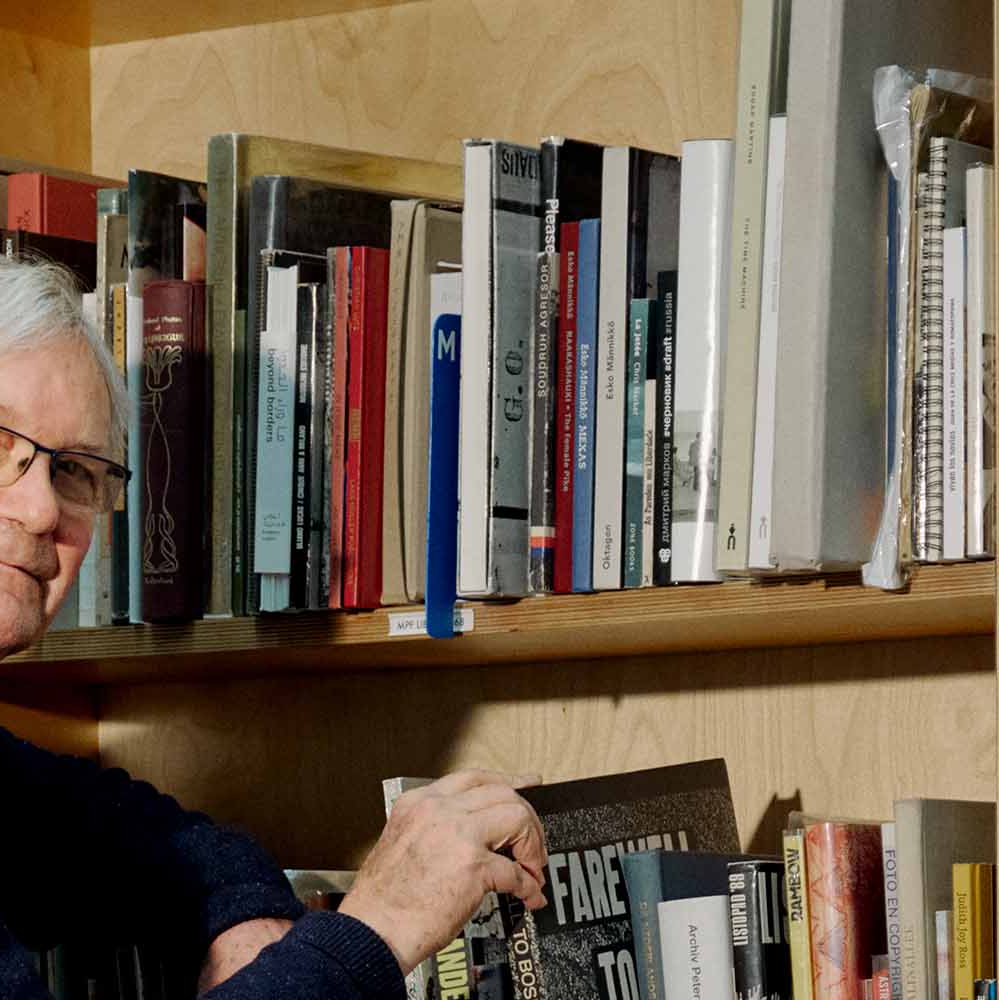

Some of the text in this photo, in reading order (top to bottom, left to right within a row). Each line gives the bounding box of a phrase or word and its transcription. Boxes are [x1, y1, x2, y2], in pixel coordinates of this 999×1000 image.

[544, 199, 560, 253] Please
[740, 266, 748, 310] MACHINE
[437, 328, 456, 361] M
[537, 264, 549, 398] SOUDRUH AGRESOR
[632, 319, 643, 385] La Chris
[562, 251, 575, 492] Esko The Female Pike
[580, 344, 589, 367] Esko
[606, 320, 616, 400] Esko Männikkö
[663, 334, 674, 373] #draft
[266, 349, 276, 443] beyond borders
[663, 373, 673, 438] #черновик
[578, 424, 587, 470] MEXAS
[661, 442, 671, 487] марков
[660, 488, 671, 543] дмитрий
[603, 524, 613, 570] Oktagon
[397, 620, 411, 629] MPF
[787, 848, 803, 922] RAMBOW
[885, 849, 897, 893] FOTO
[730, 894, 748, 946] LISTOPAD
[887, 898, 898, 918] EN
[957, 892, 969, 925] Judith
[510, 928, 529, 955] TO
[687, 924, 700, 962] Archiv
[957, 927, 969, 944] Joy
[958, 947, 969, 969] Ross
[690, 966, 702, 1000] Peter
